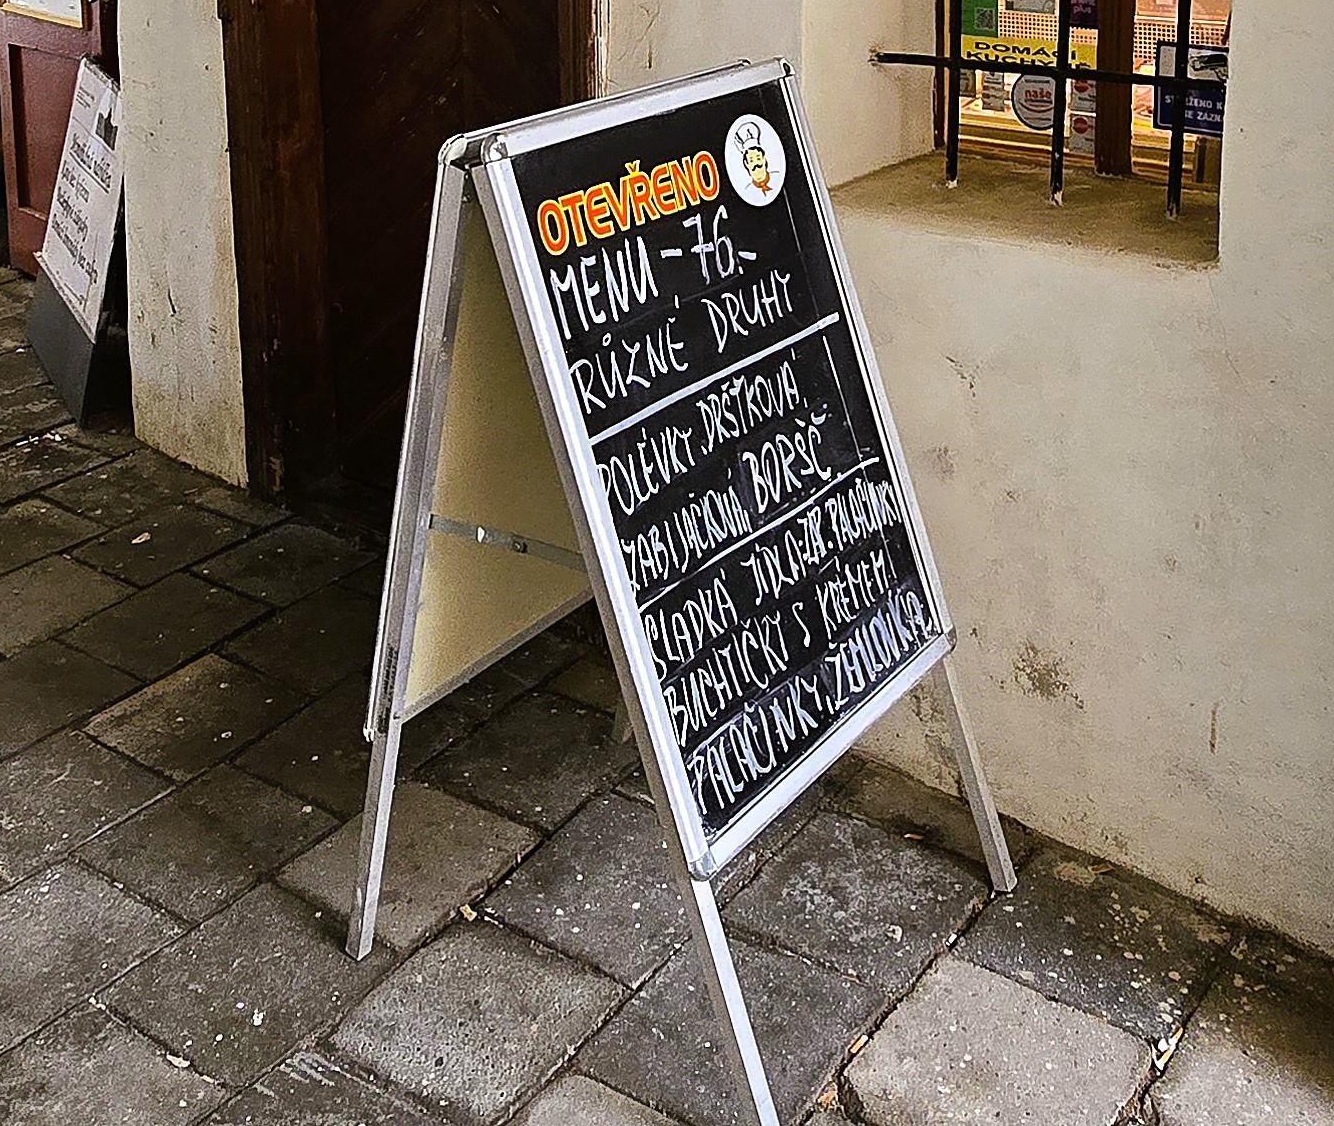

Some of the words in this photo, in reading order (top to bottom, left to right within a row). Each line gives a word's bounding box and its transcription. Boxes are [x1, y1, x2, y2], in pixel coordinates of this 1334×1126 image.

[537, 151, 721, 256] OTEVŘENO
[549, 235, 659, 340] MENU
[701, 269, 792, 354] DRUHY
[644, 568, 738, 682] SLADKÁ
[663, 610, 789, 748] BUCHTIČKY
[792, 601, 811, 647] S
